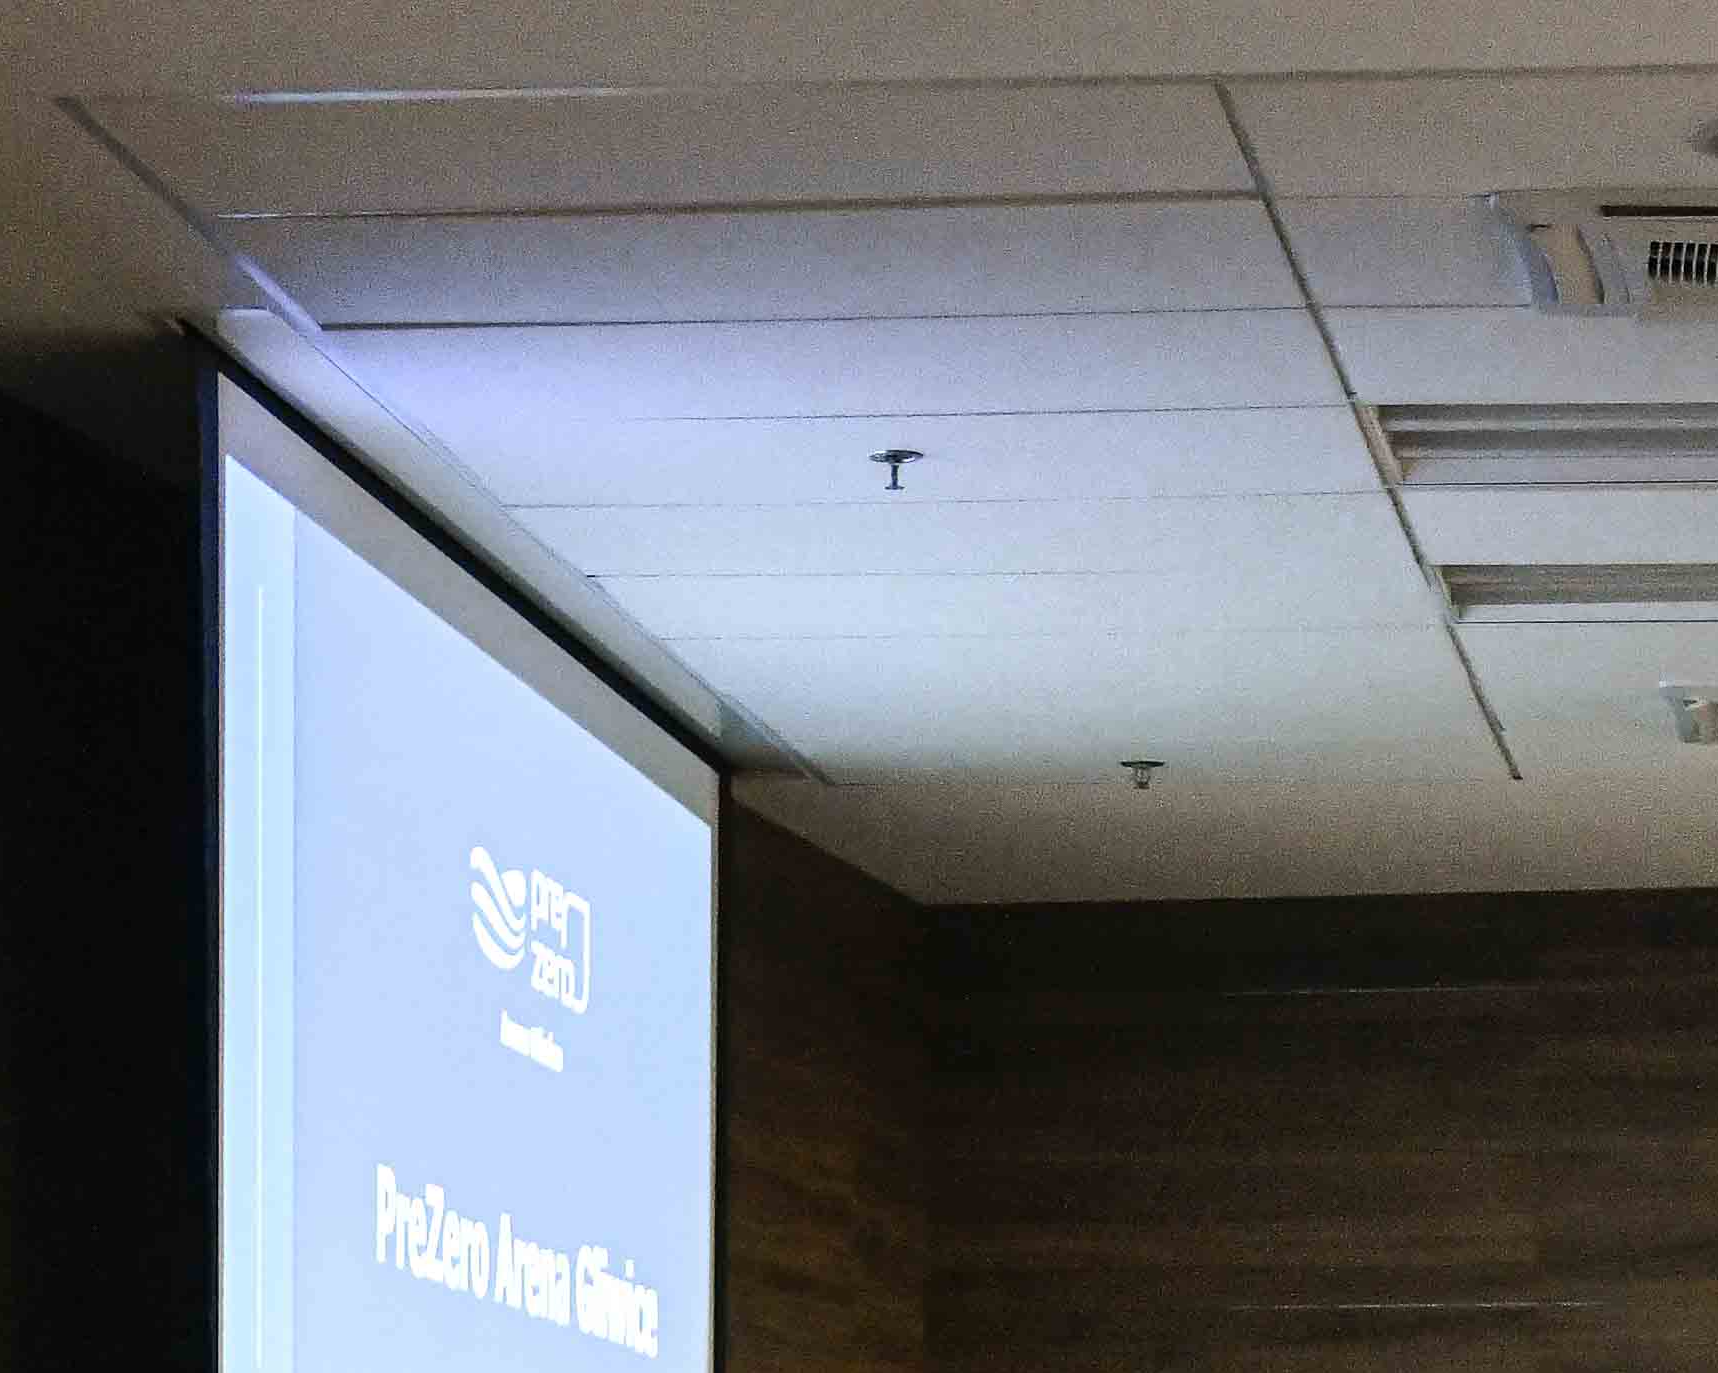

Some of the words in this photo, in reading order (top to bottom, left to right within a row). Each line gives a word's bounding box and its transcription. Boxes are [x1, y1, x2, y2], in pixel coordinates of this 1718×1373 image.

[377, 1163, 489, 1299] PreZero
[494, 1213, 570, 1326] Arena
[576, 1245, 658, 1358] Gliwice
